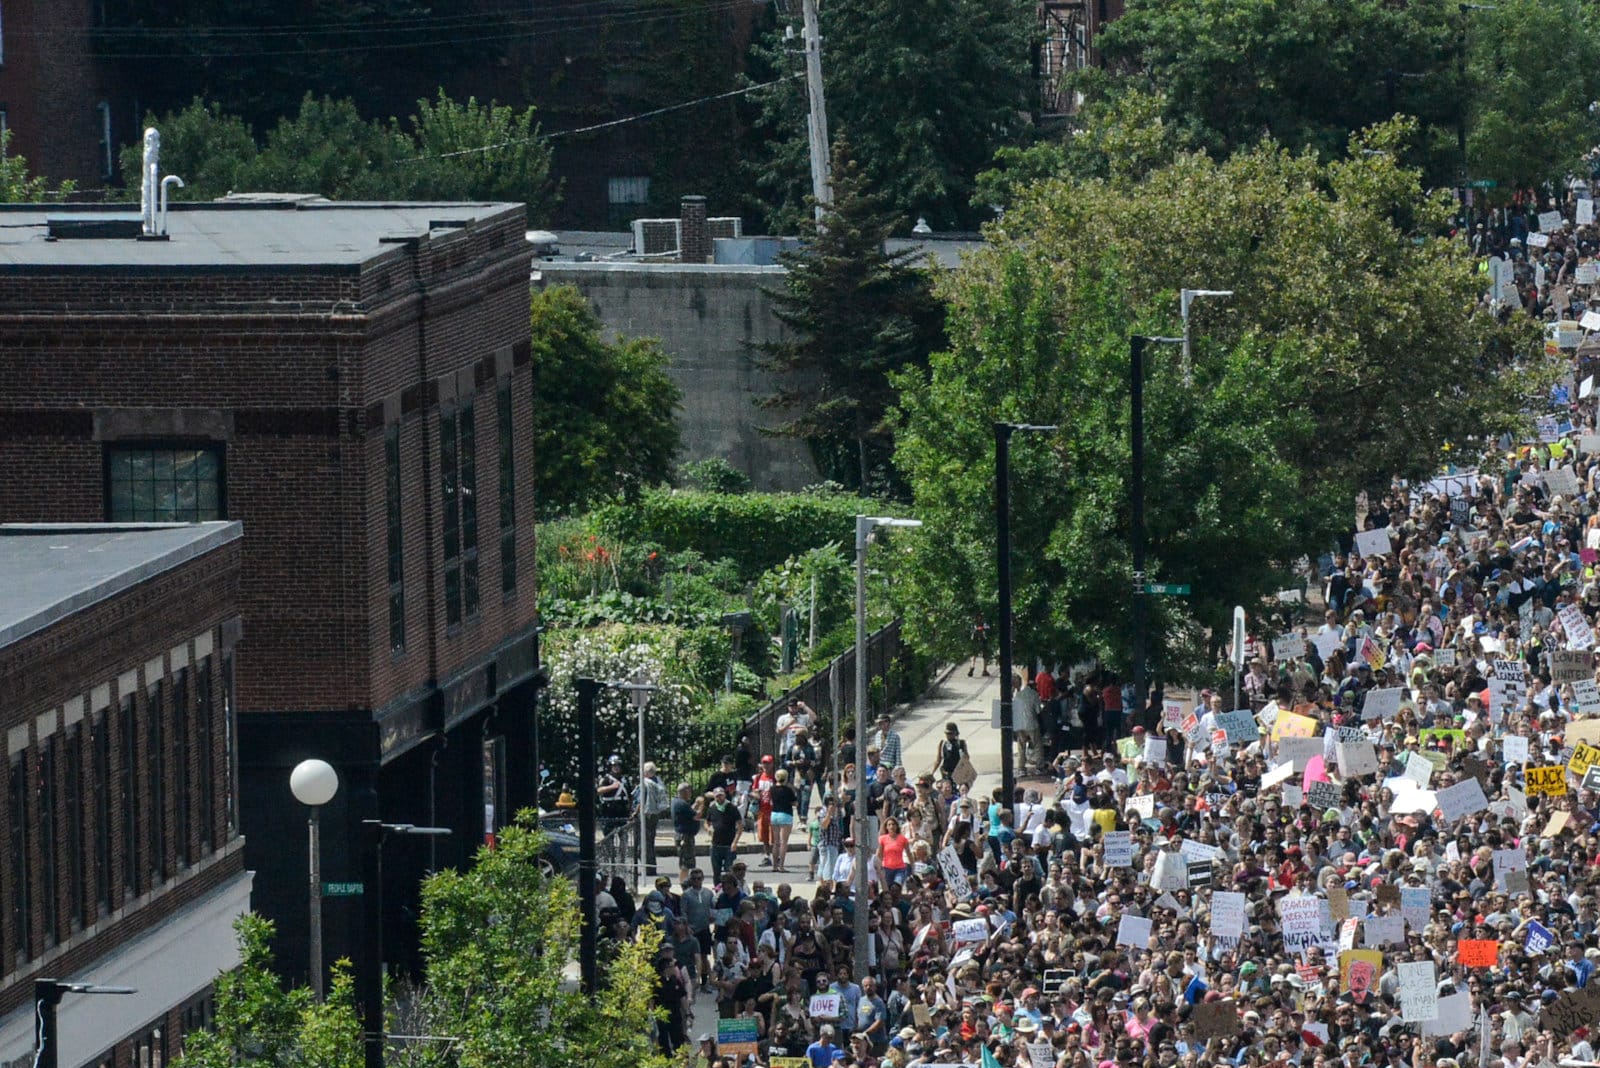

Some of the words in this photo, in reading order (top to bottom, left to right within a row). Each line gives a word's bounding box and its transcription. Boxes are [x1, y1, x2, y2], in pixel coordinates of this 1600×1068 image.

[1554, 654, 1581, 663] LOVE
[1496, 661, 1519, 671] HATE
[1527, 769, 1563, 785] BLACK
[811, 1002, 834, 1014] LOVE
